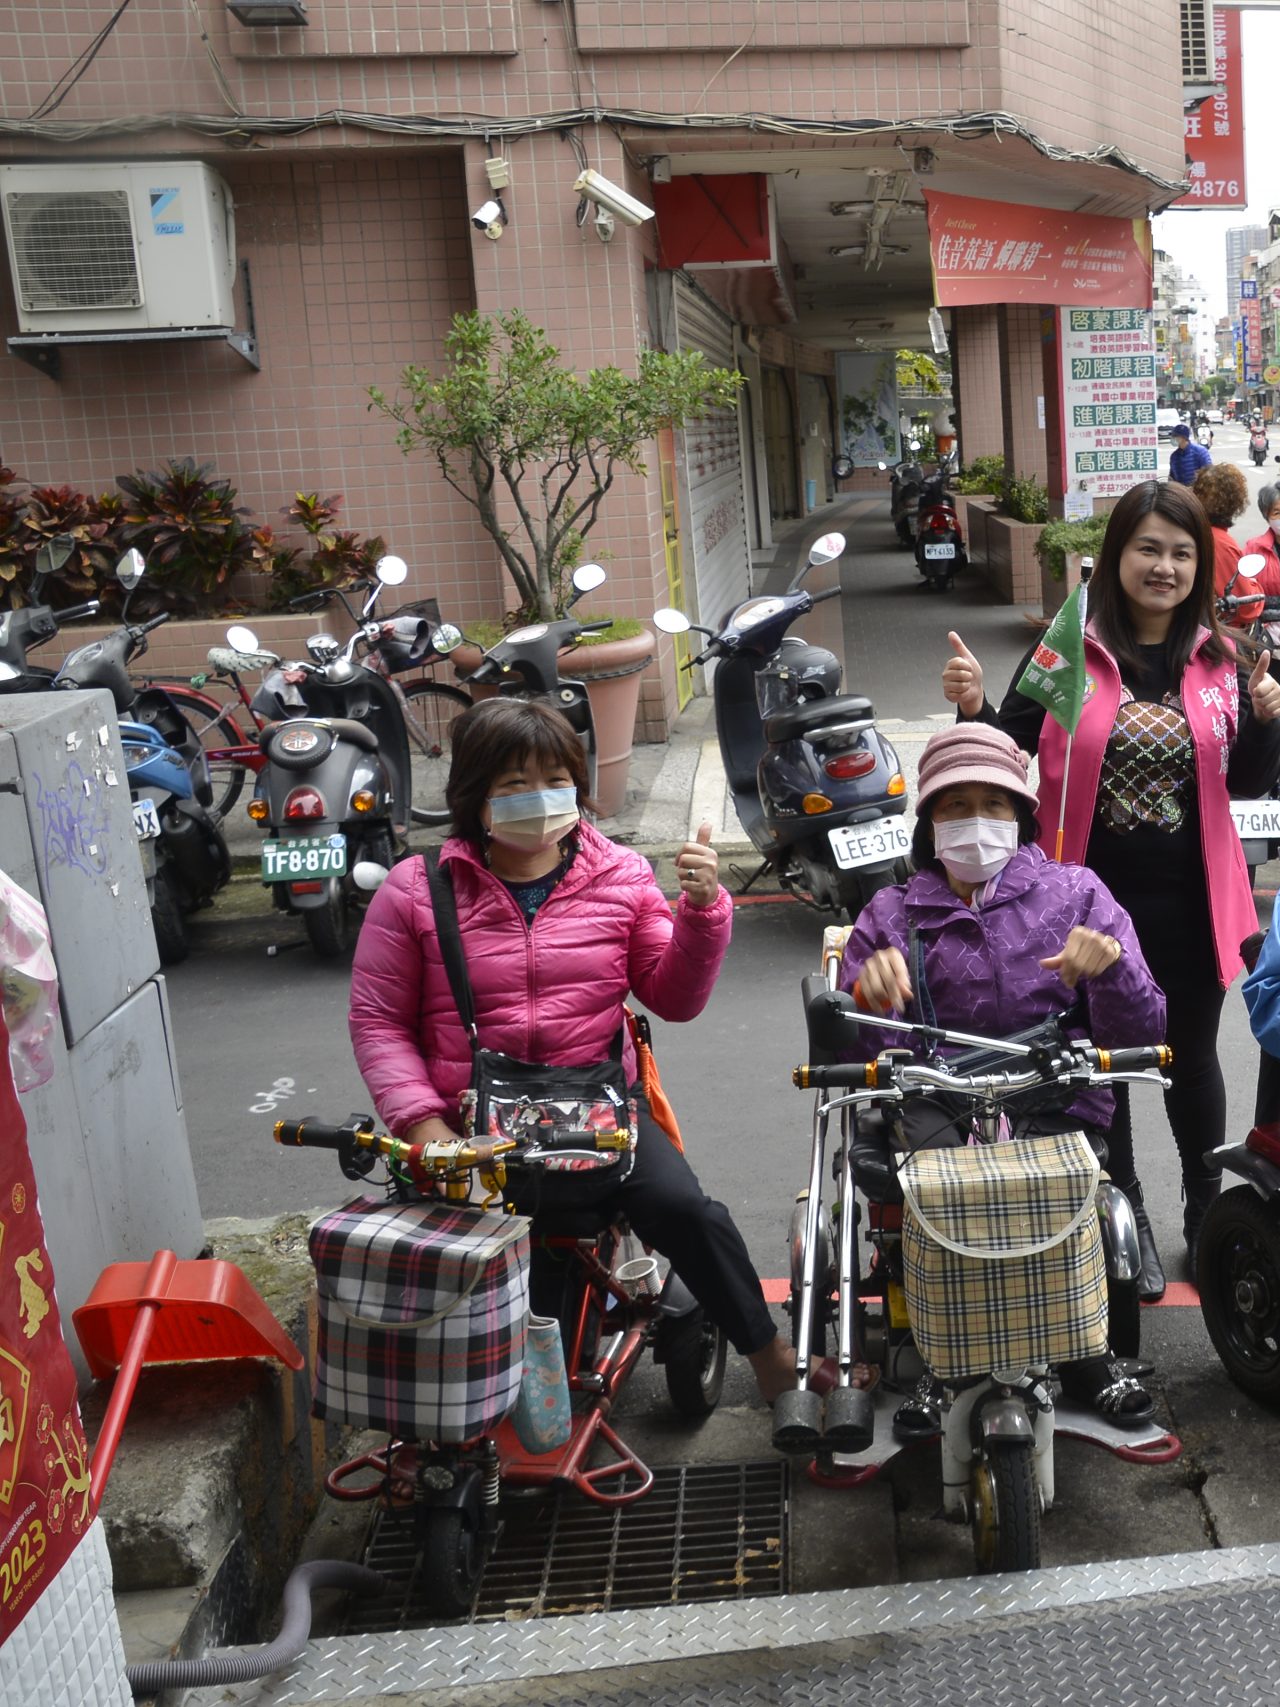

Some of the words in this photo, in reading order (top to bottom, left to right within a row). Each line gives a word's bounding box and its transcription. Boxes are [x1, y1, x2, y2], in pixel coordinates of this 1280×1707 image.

[1190, 180, 1239, 197] 4876
[938, 234, 998, 270] 佳音英語
[1073, 357, 1152, 378] 初階課程
[1075, 404, 1153, 425] 進階課程
[1077, 450, 1155, 472] 高階課程
[0, 1519, 46, 1603] 2023
